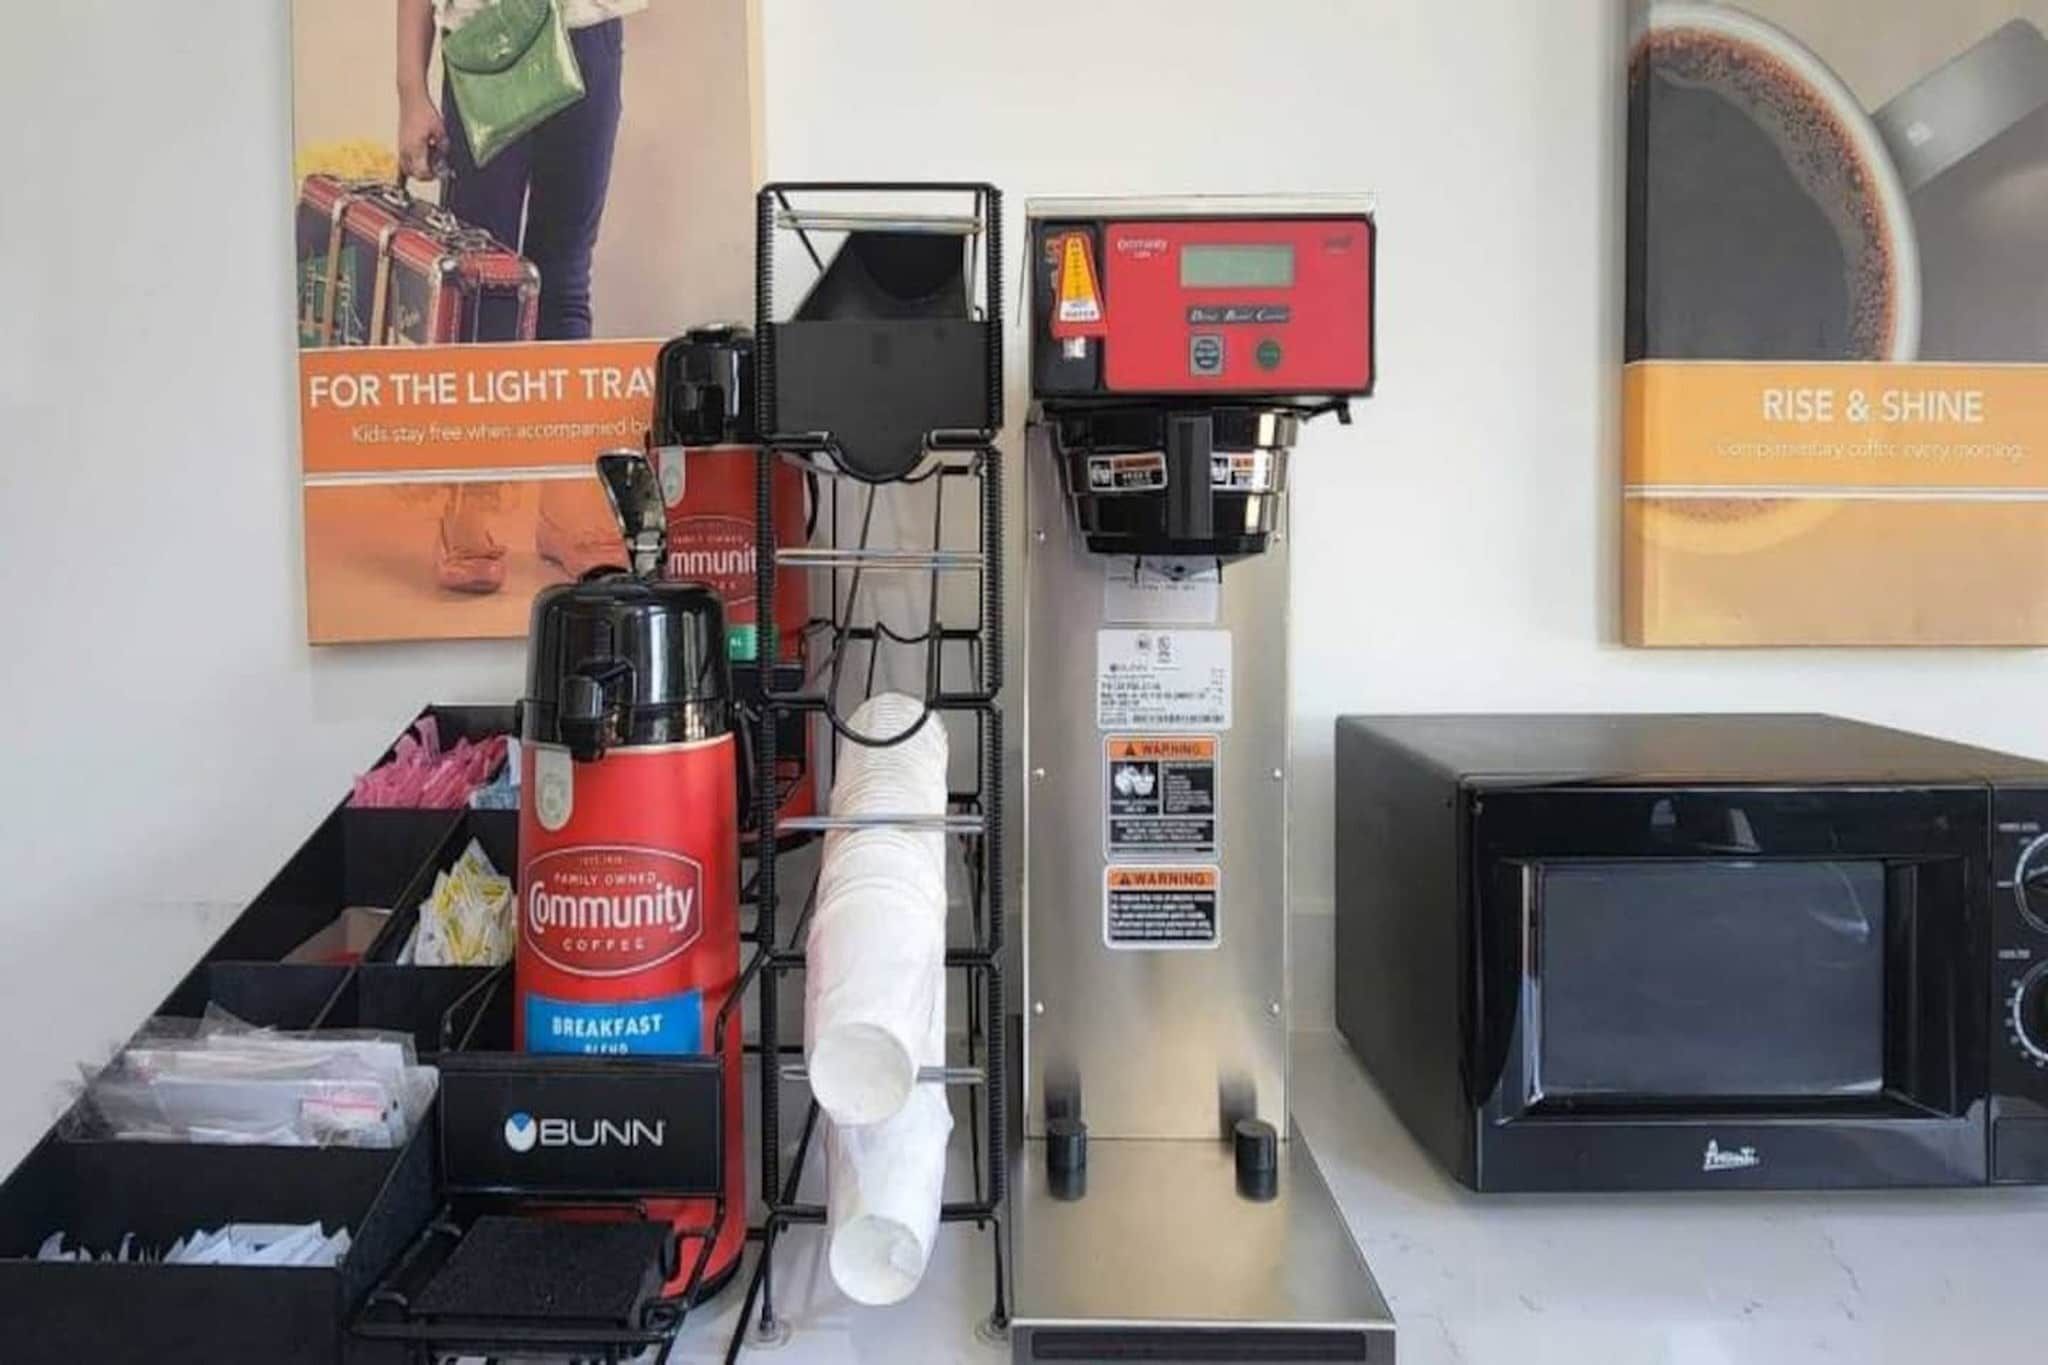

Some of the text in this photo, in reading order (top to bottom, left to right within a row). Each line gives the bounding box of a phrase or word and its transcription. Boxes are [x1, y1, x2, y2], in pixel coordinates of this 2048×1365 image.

[310, 373, 380, 408] FOR
[389, 371, 457, 405] THE
[468, 367, 569, 403] LIGHT
[1763, 388, 1984, 423] RISE & SHINE
[352, 424, 389, 443] Kids
[391, 425, 425, 445] stay
[430, 421, 462, 441] free
[464, 421, 513, 440] when
[517, 416, 625, 442] accompanied
[1141, 741, 1202, 756] WARNING
[553, 870, 657, 887] FAMILY OWNED
[1135, 872, 1206, 885] WARNING
[529, 881, 694, 934] Community
[562, 937, 646, 952] COFFEE
[552, 1013, 664, 1037] BREAKFAST
[540, 1118, 664, 1147] BUNN
